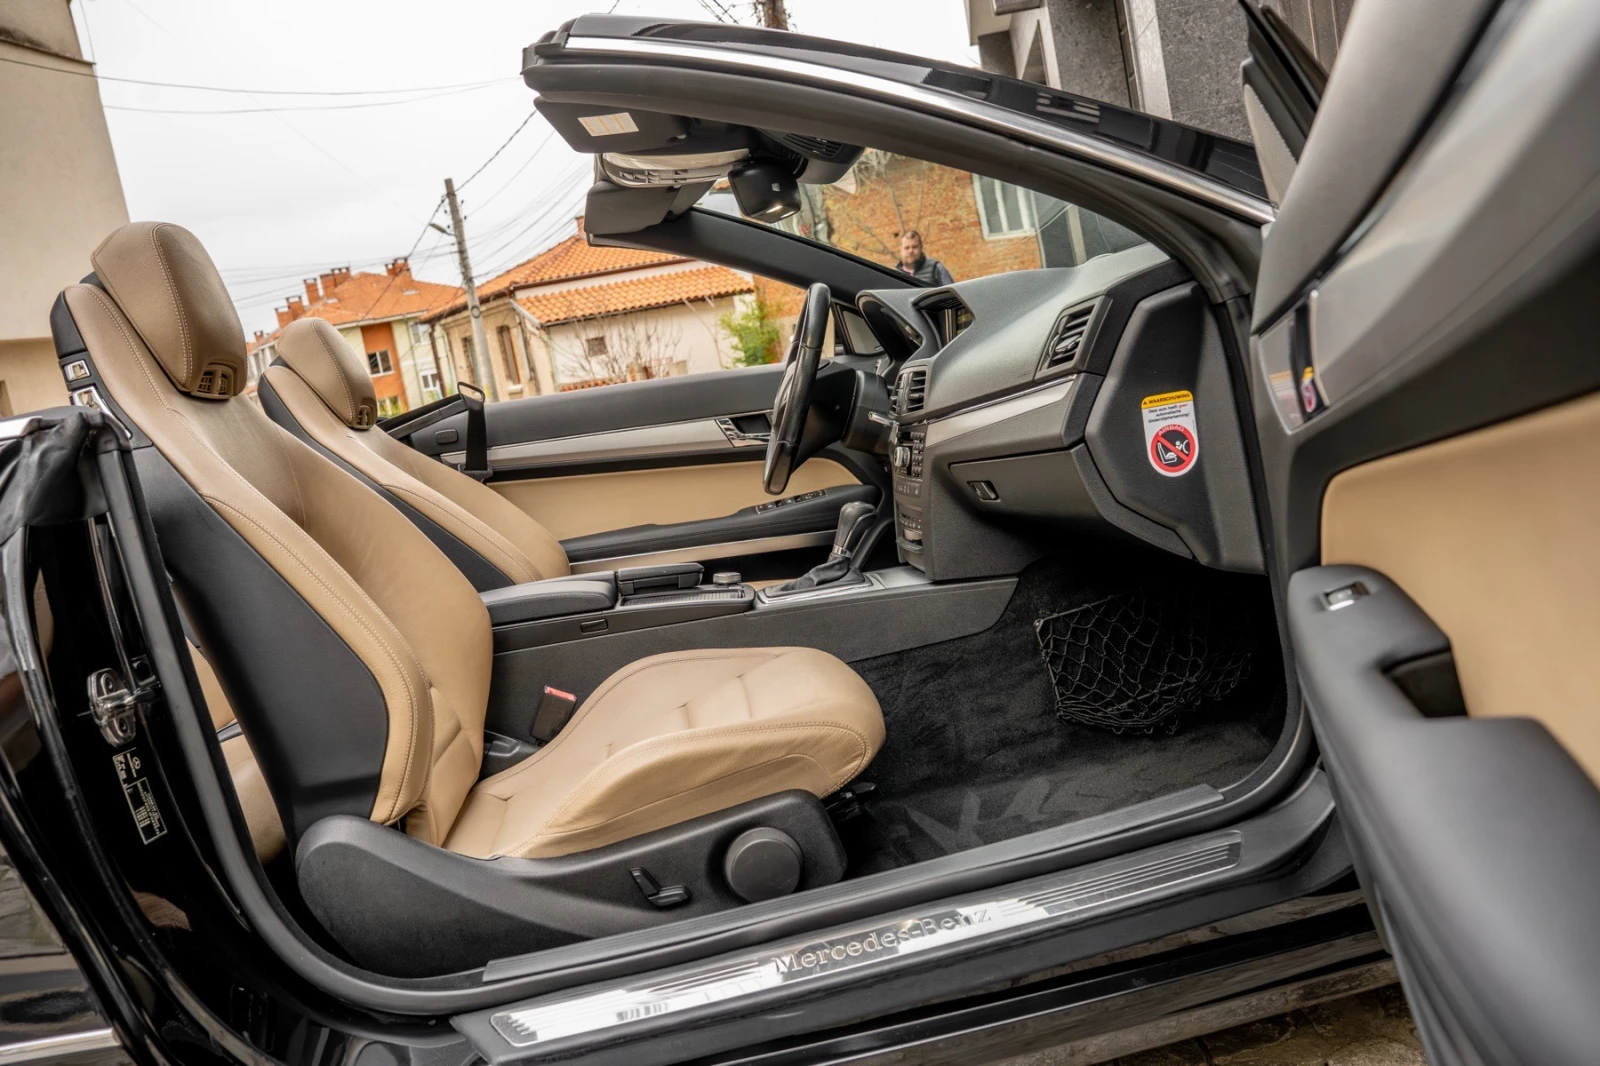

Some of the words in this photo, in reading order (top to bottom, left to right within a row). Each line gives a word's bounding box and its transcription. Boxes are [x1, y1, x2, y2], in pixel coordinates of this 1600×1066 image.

[1148, 393, 1190, 404] WAARSCHUWING
[1158, 425, 1185, 436] AIRBAG
[774, 908, 992, 974] Mercedes-Benz
